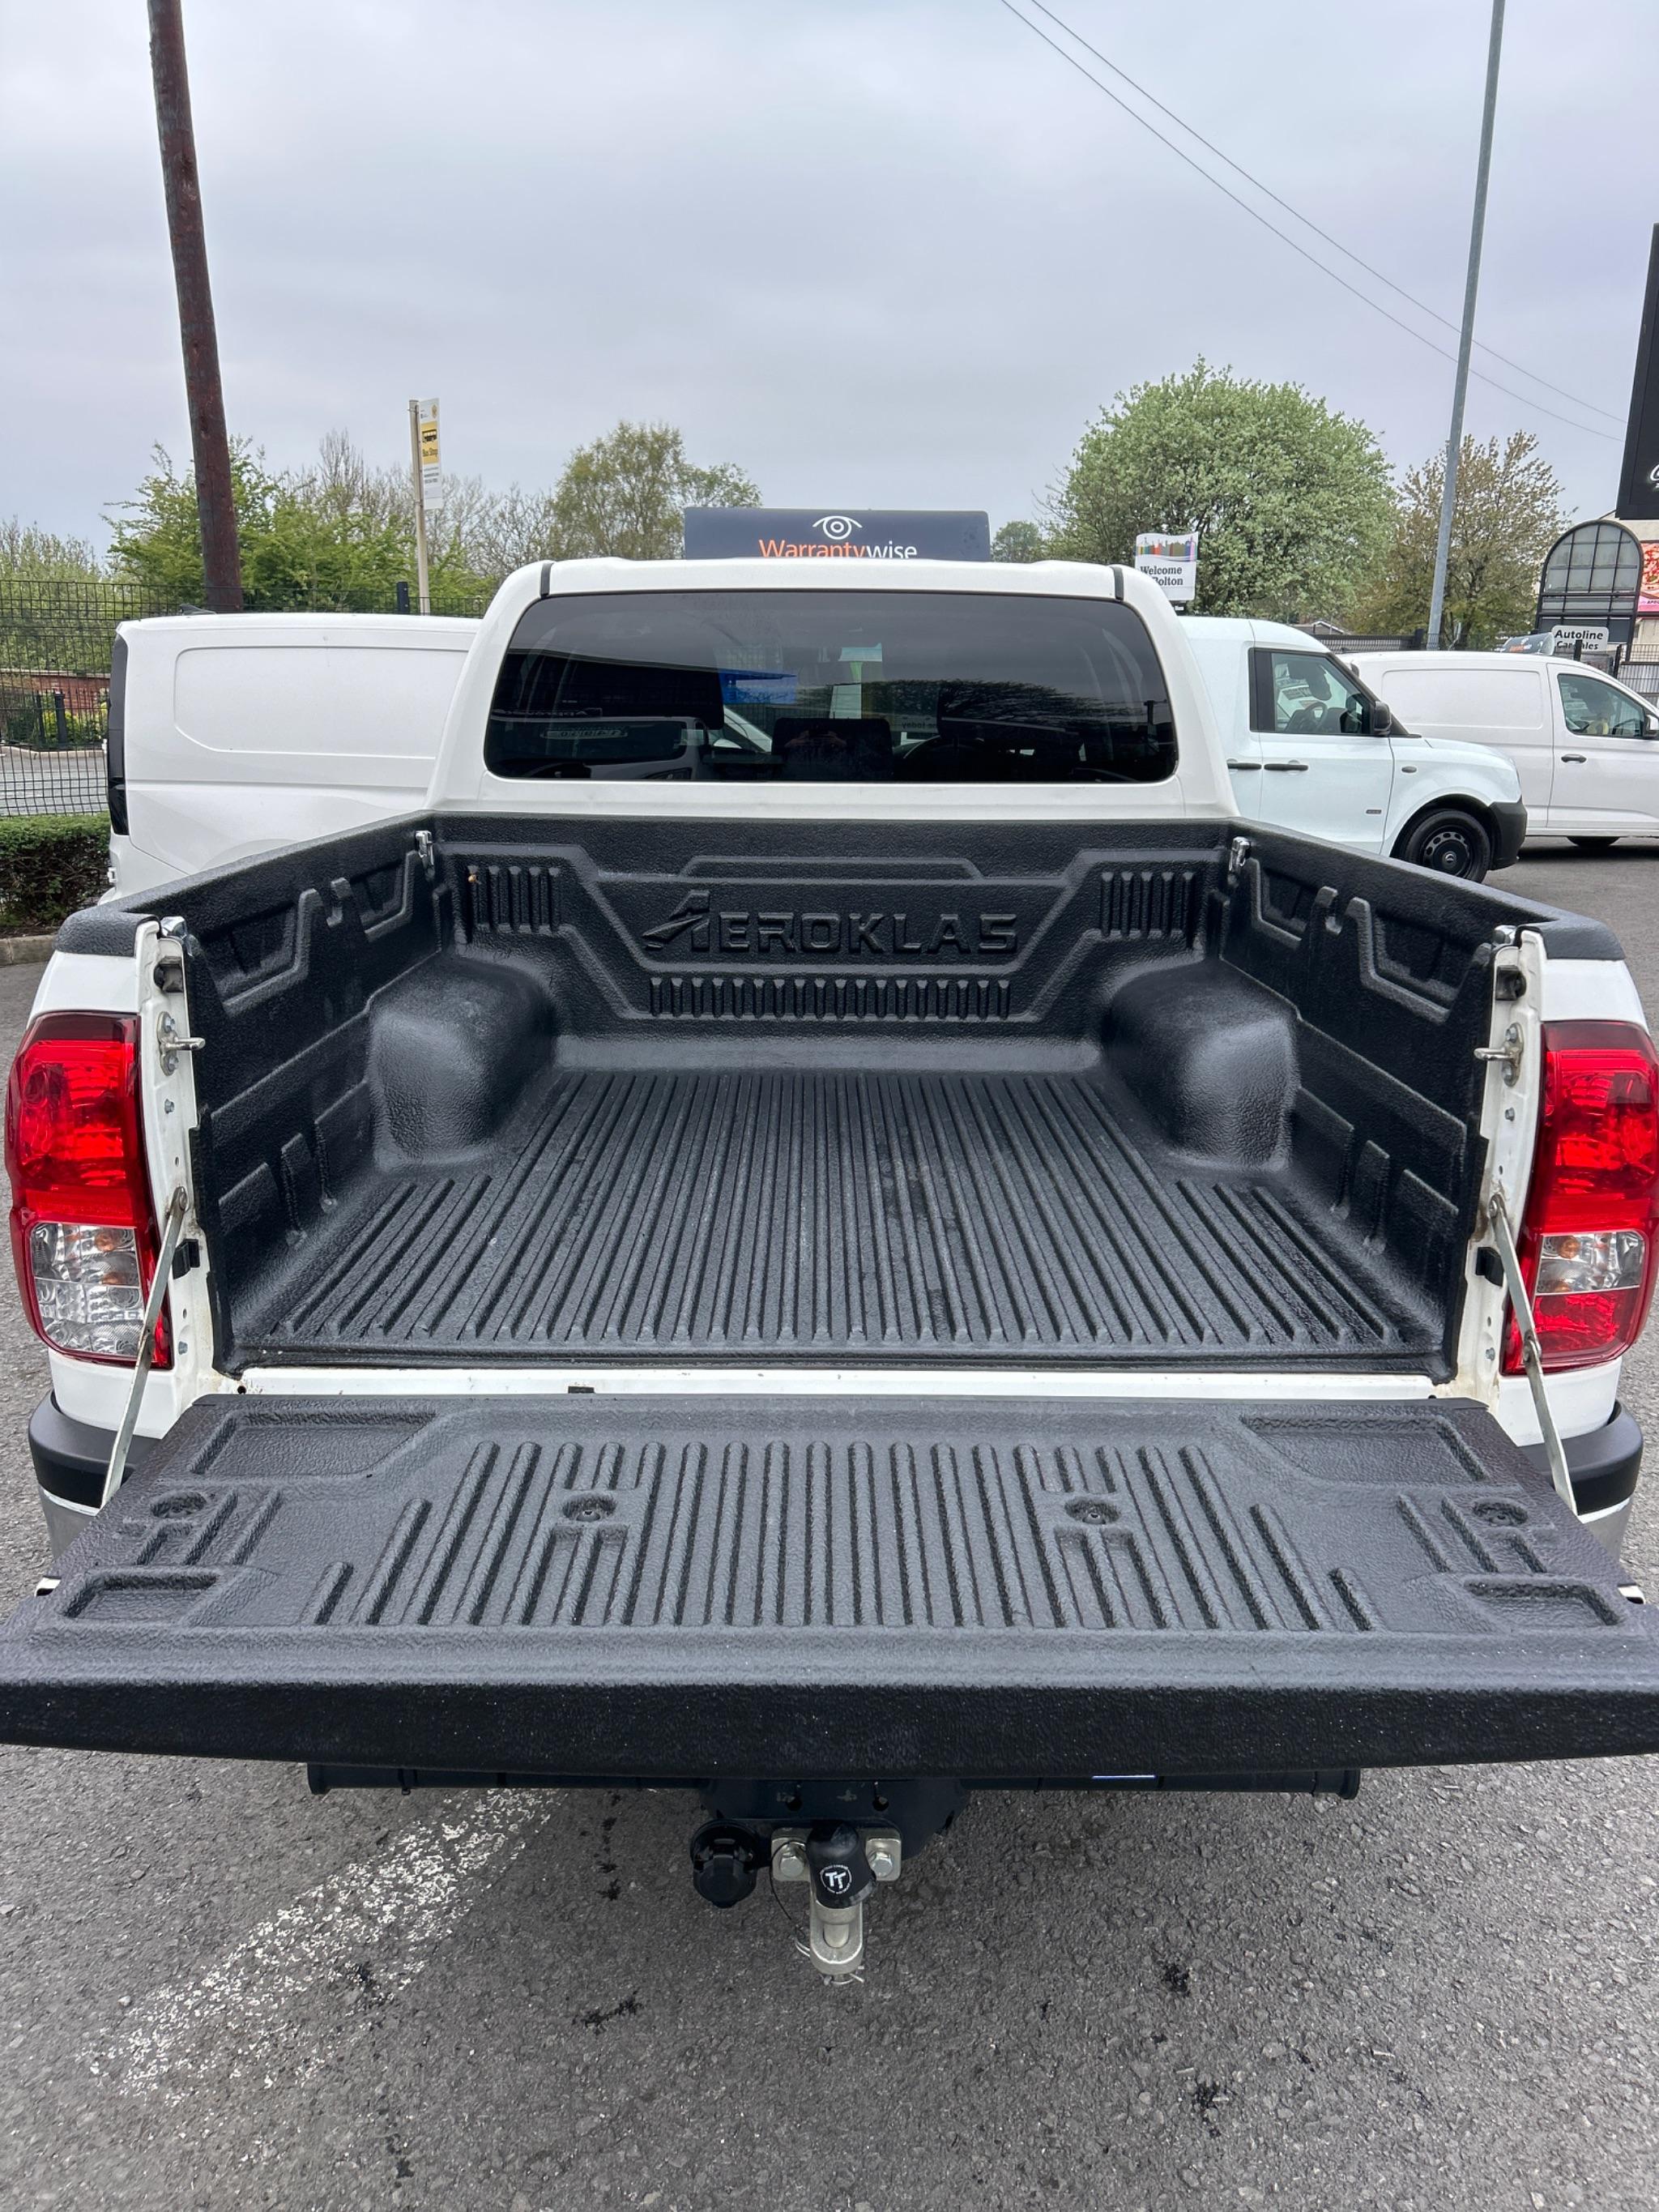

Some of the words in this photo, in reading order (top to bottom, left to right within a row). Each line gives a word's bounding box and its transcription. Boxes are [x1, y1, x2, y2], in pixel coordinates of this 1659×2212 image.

[758, 539, 918, 559] Warrantywise
[1141, 566, 1183, 574] Welcome
[1555, 630, 1604, 639] Autoline
